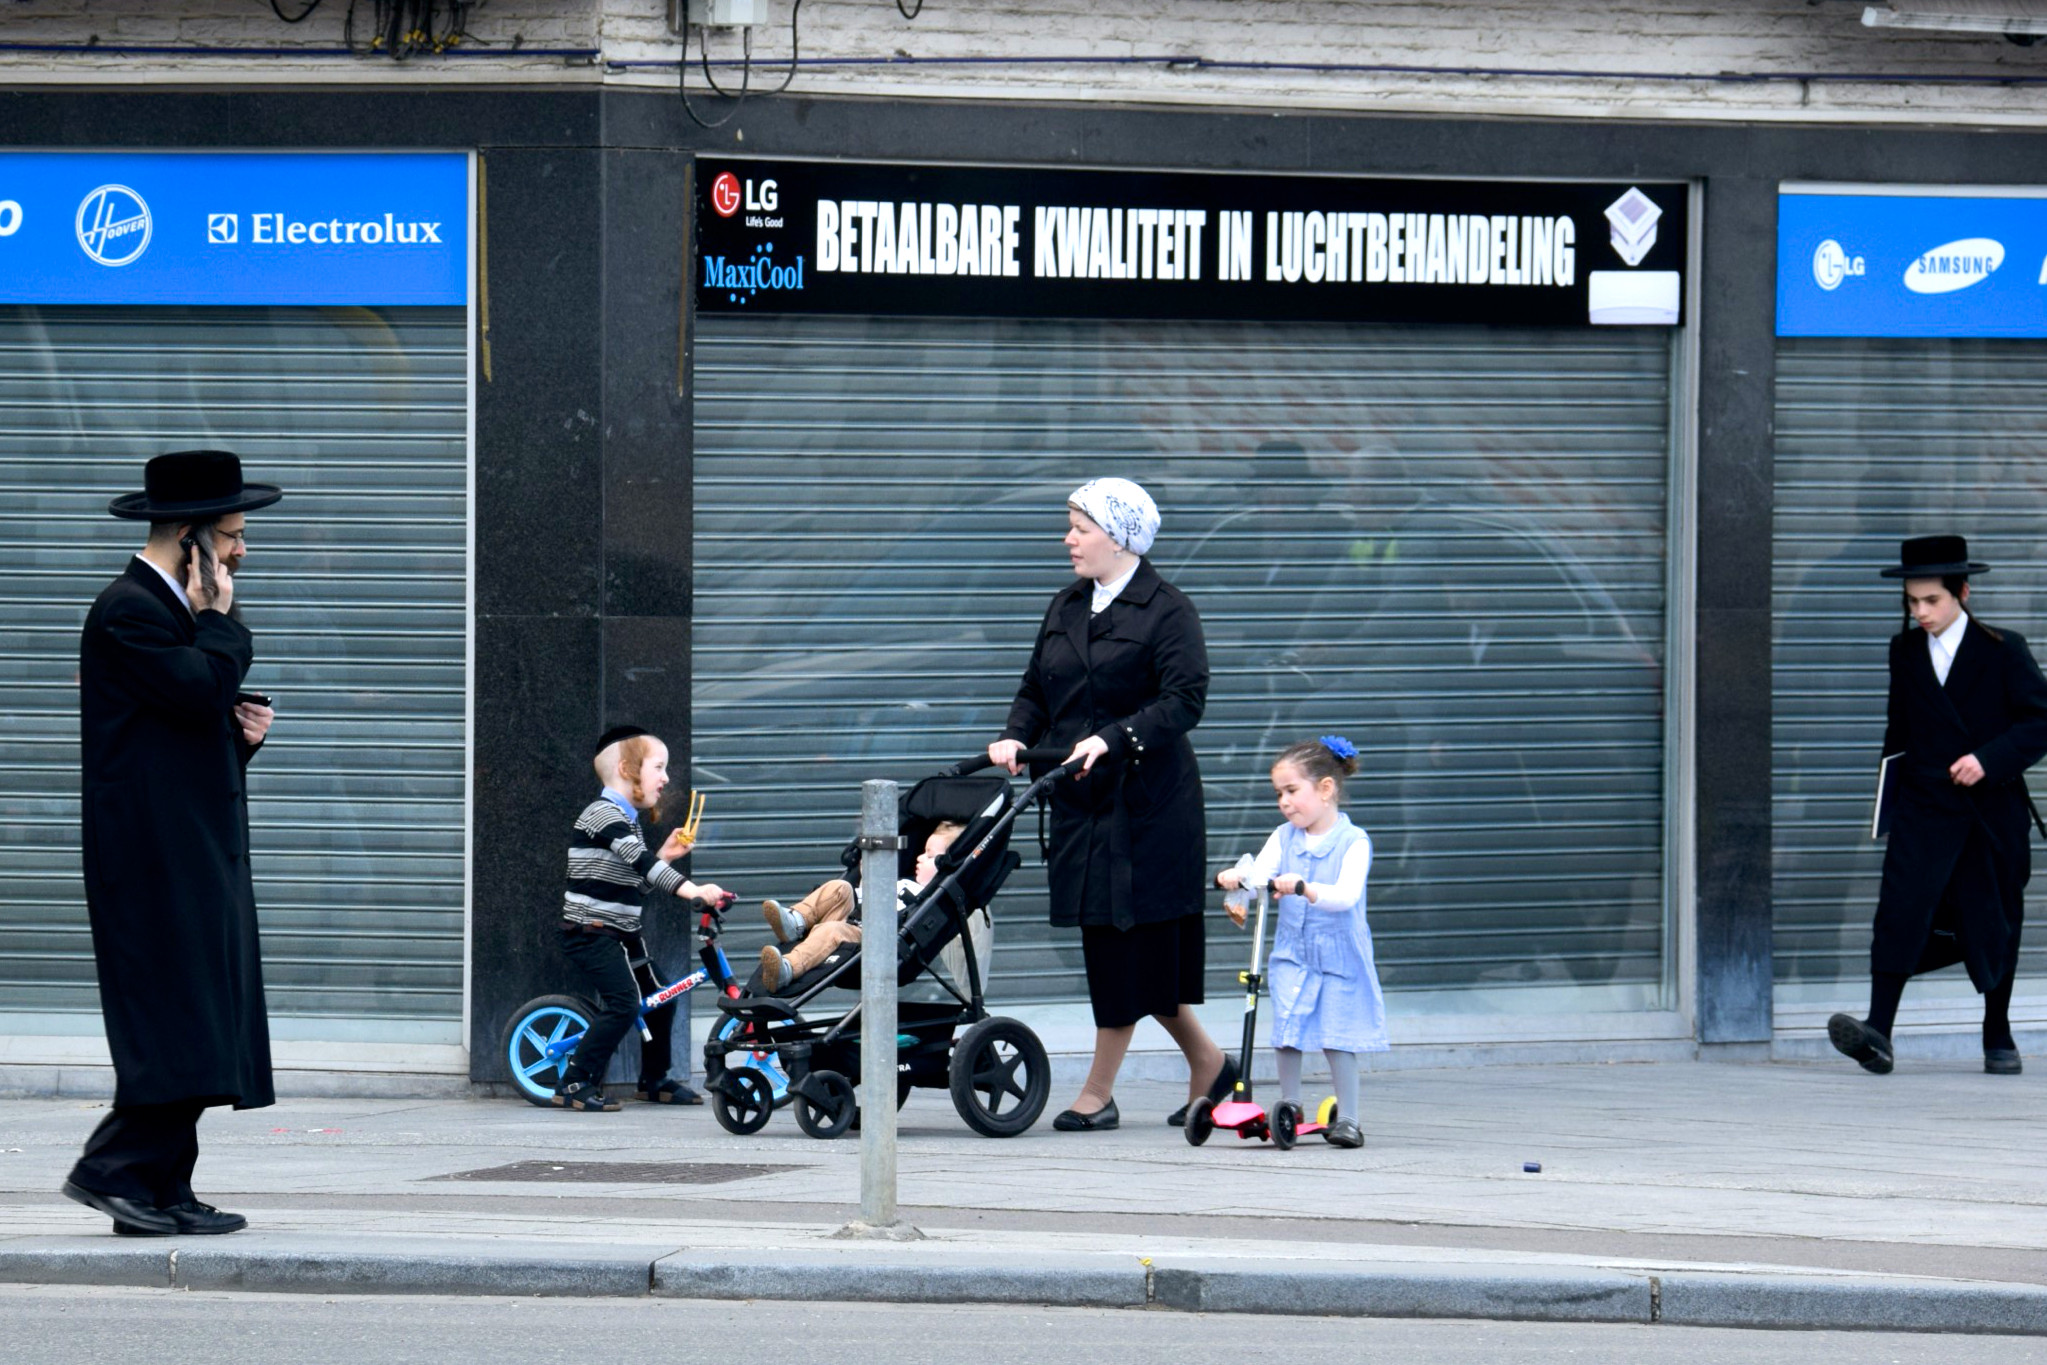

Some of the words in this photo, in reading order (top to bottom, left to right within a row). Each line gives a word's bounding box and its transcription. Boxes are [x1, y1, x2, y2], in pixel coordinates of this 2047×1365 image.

[746, 179, 778, 211] LG
[252, 213, 443, 244] Electrolux
[745, 216, 764, 228] Life's
[764, 217, 784, 228] Good
[816, 199, 1020, 277] BETAALBARE
[1034, 205, 1207, 281] KWALITEIT
[1218, 210, 1253, 282] IN
[1266, 211, 1577, 287] LUCHTBEHANDELING
[703, 255, 804, 289] MaxiCool
[1844, 256, 1866, 276] LG
[1918, 256, 1993, 275] SAMSUNG
[658, 978, 694, 1003] RUNNER
